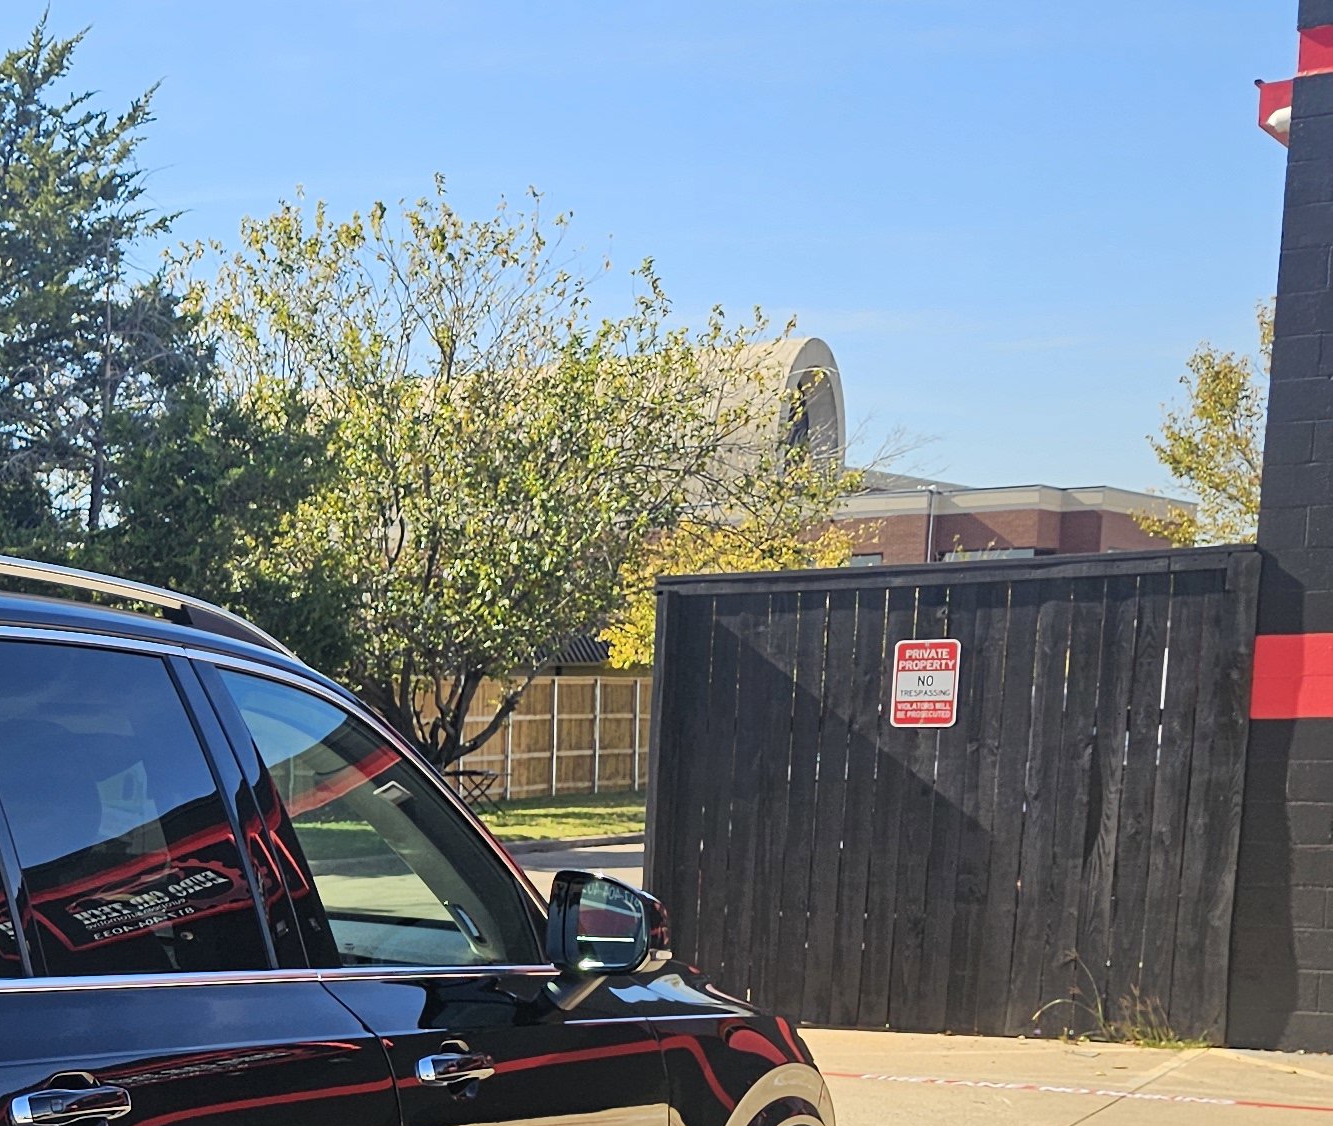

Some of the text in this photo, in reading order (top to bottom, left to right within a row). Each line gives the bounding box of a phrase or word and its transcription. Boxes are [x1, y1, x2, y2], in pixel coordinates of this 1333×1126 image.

[905, 648, 950, 659] PRIVATE
[898, 660, 955, 671] PROPERTY
[917, 675, 934, 687] NO
[900, 689, 951, 697] TRESPASSING
